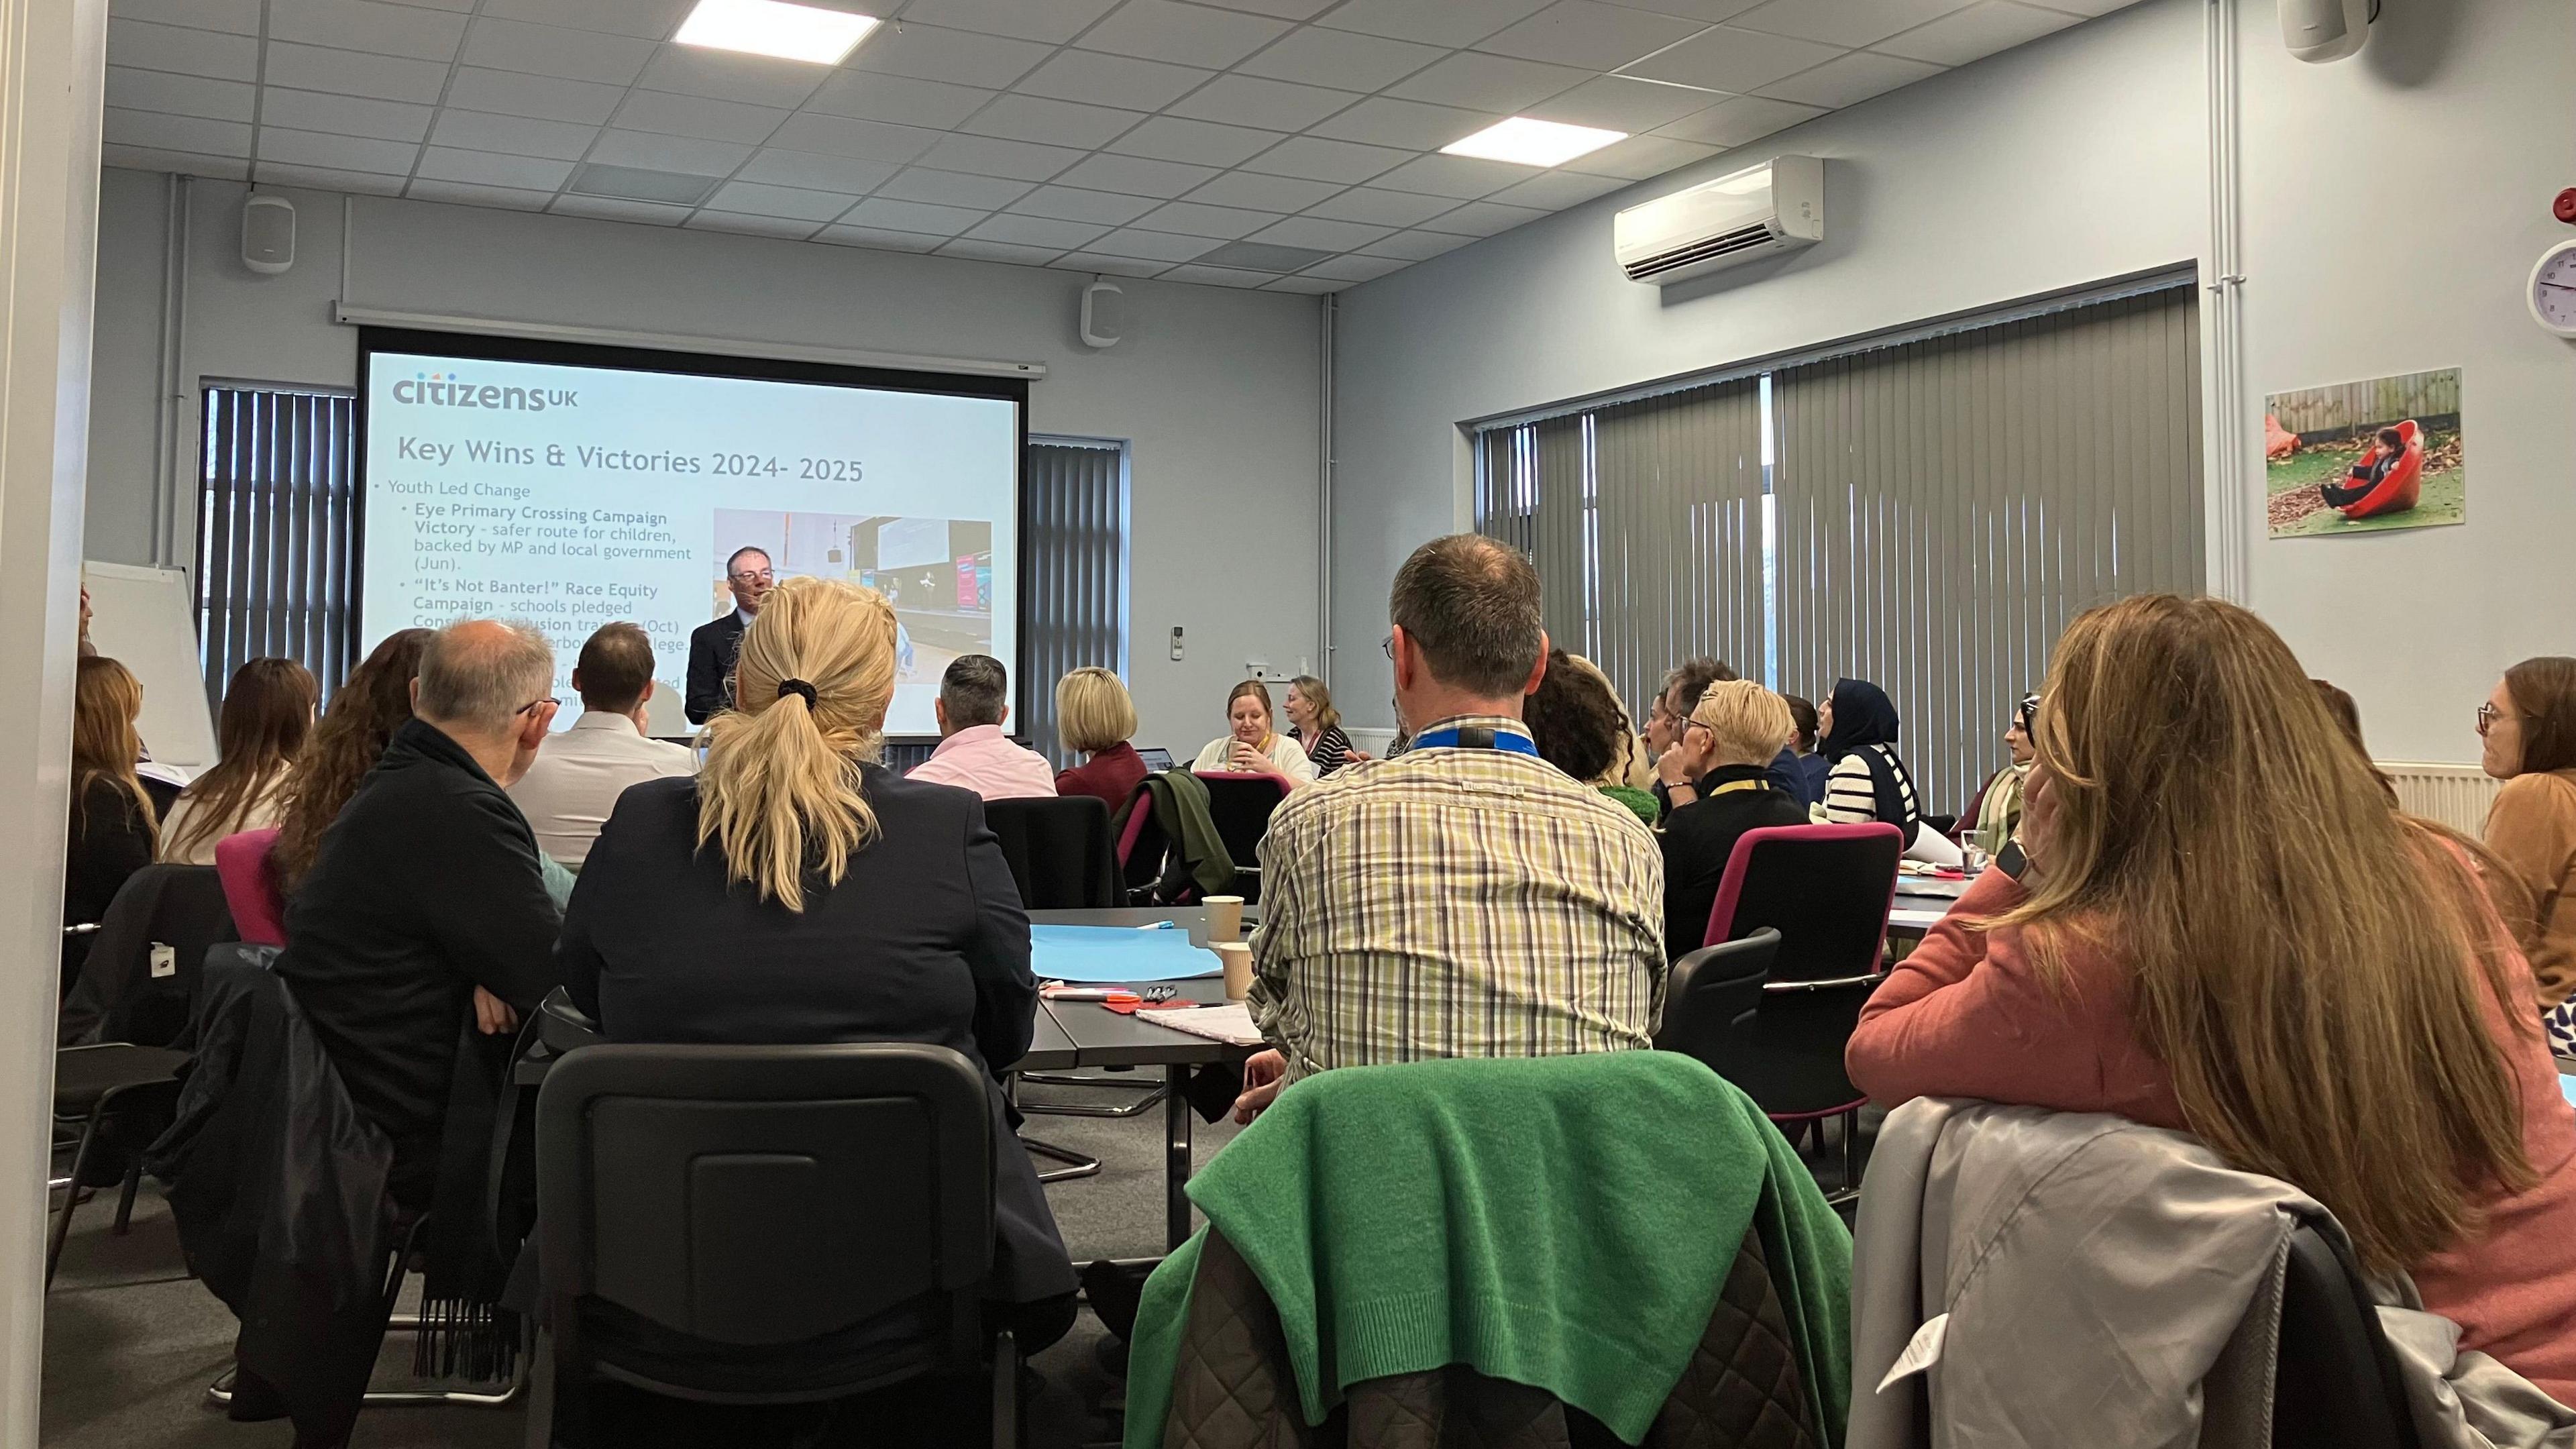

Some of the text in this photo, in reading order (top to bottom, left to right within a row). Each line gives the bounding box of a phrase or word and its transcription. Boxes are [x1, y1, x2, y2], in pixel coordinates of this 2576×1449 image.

[2561, 315, 2566, 323] 7
[398, 436, 863, 482] Key Wins & Victories 2024- 2025
[388, 480, 531, 500] Youth Led Change
[415, 503, 667, 527] Eye Primary Crossing Campaign
[415, 521, 476, 537] Victory
[492, 523, 531, 537] safer
[537, 527, 578, 539] route
[584, 526, 605, 539] for
[610, 527, 676, 544] children,
[414, 539, 692, 560] backed by MP and local government
[415, 557, 462, 572] (Jun).
[415, 578, 659, 600] “It’s Not Banter!” Race Equity
[413, 596, 493, 614] Campaign
[510, 599, 566, 612] schools
[572, 601, 632, 616] pledged
